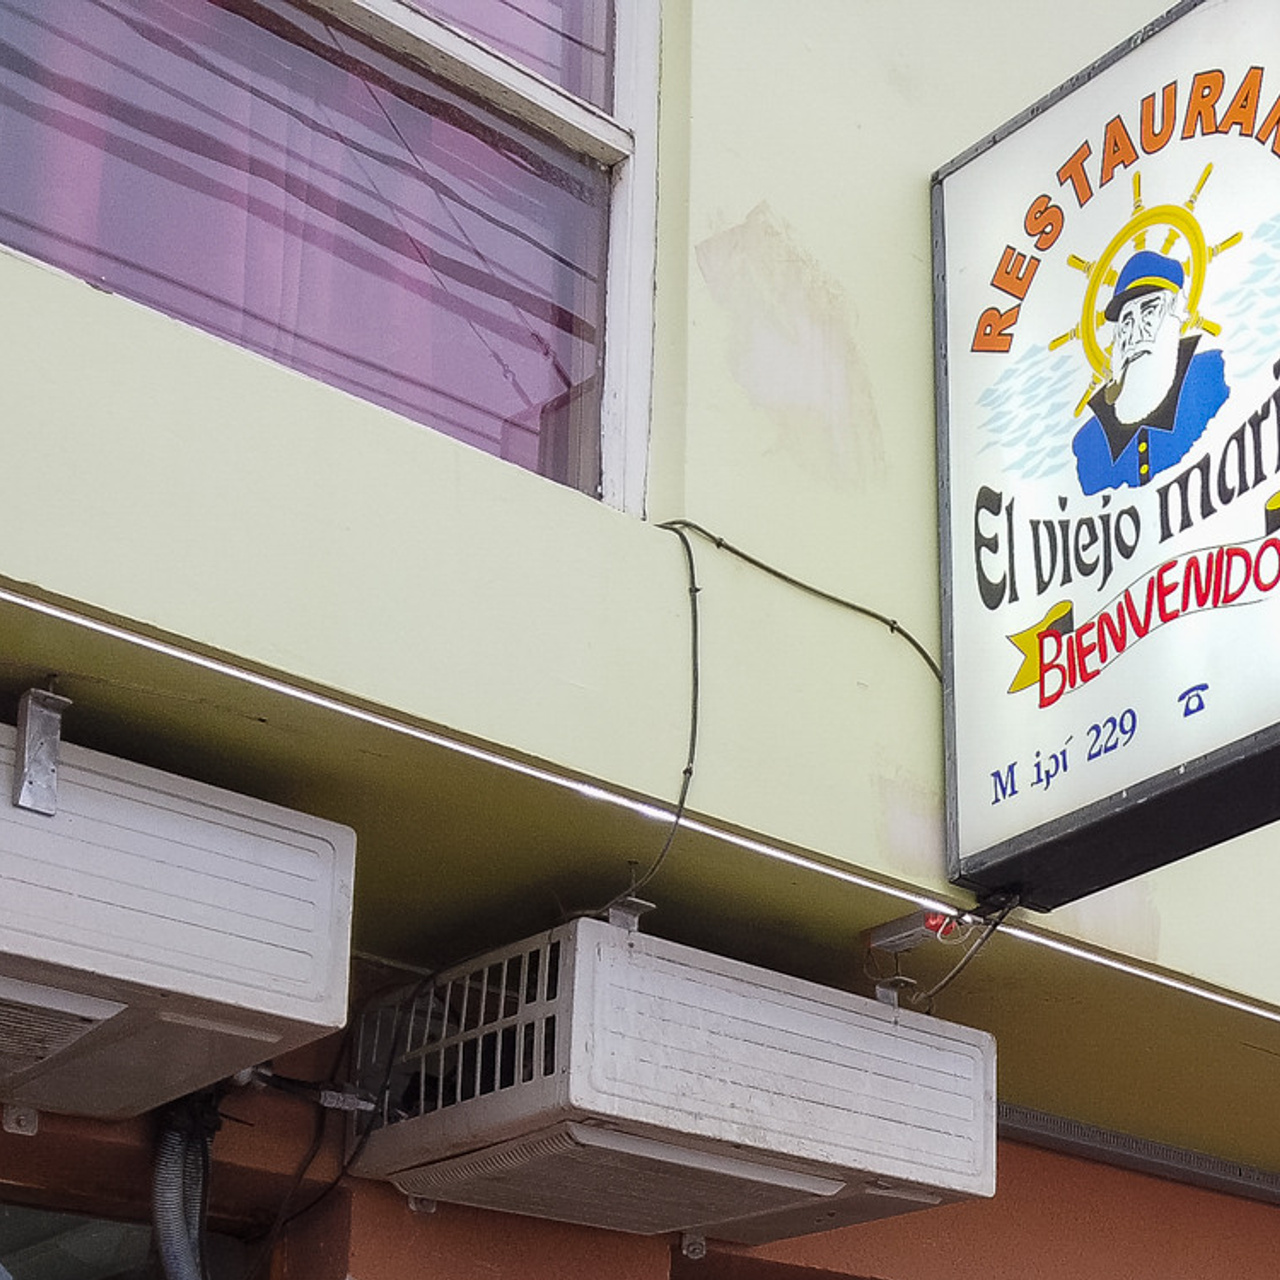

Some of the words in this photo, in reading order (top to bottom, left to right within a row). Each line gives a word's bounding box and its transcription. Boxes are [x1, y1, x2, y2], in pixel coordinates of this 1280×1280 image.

[974, 485, 1019, 611] El
[1029, 492, 1141, 597] viejo
[1087, 708, 1137, 761] 229
